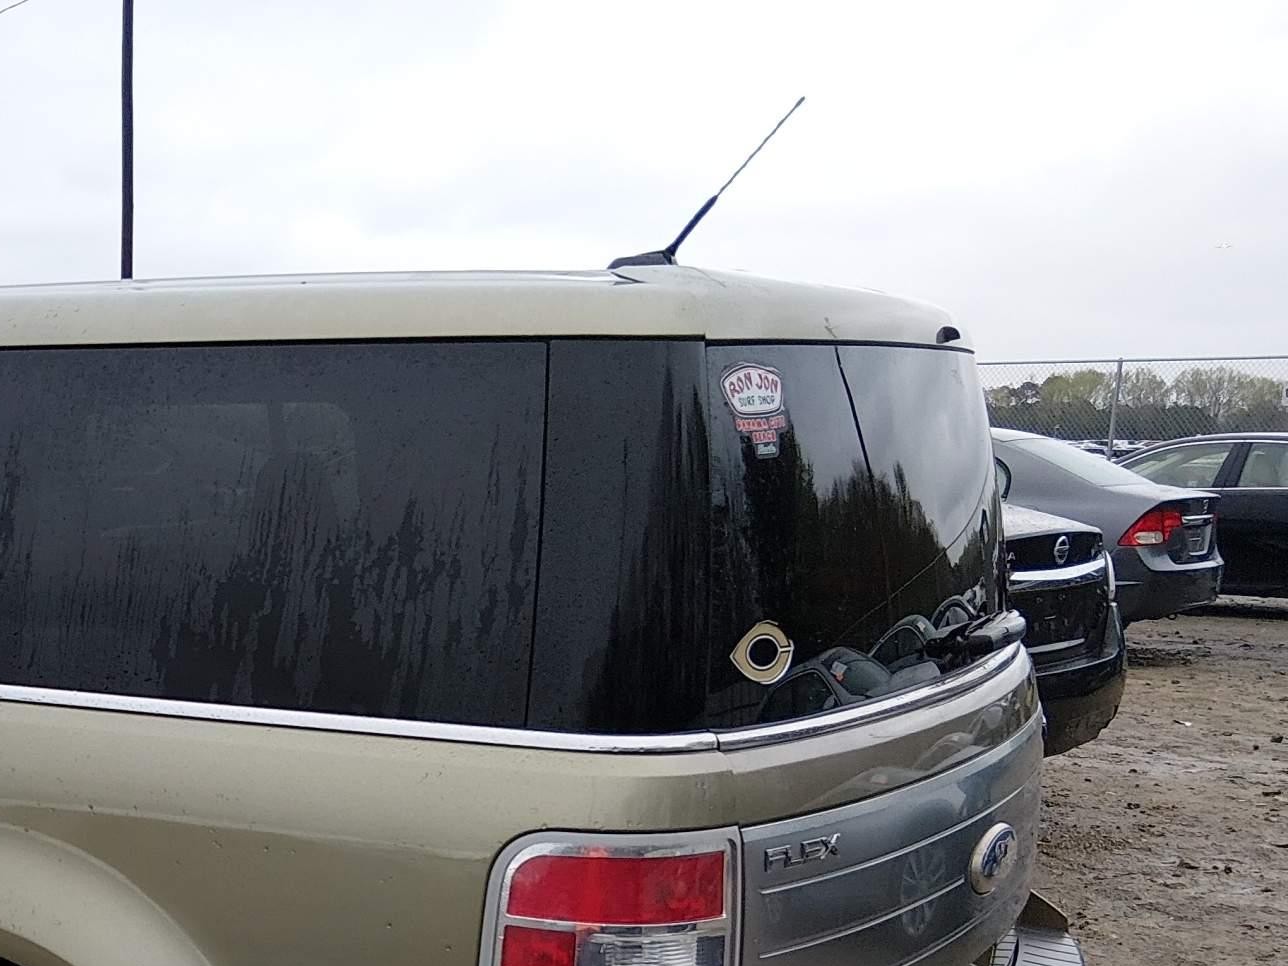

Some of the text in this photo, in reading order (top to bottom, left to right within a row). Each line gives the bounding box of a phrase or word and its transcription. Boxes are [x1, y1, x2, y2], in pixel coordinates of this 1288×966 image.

[728, 371, 779, 398] RON JON
[739, 394, 775, 408] SURF SHOP
[764, 832, 841, 873] FLEX
